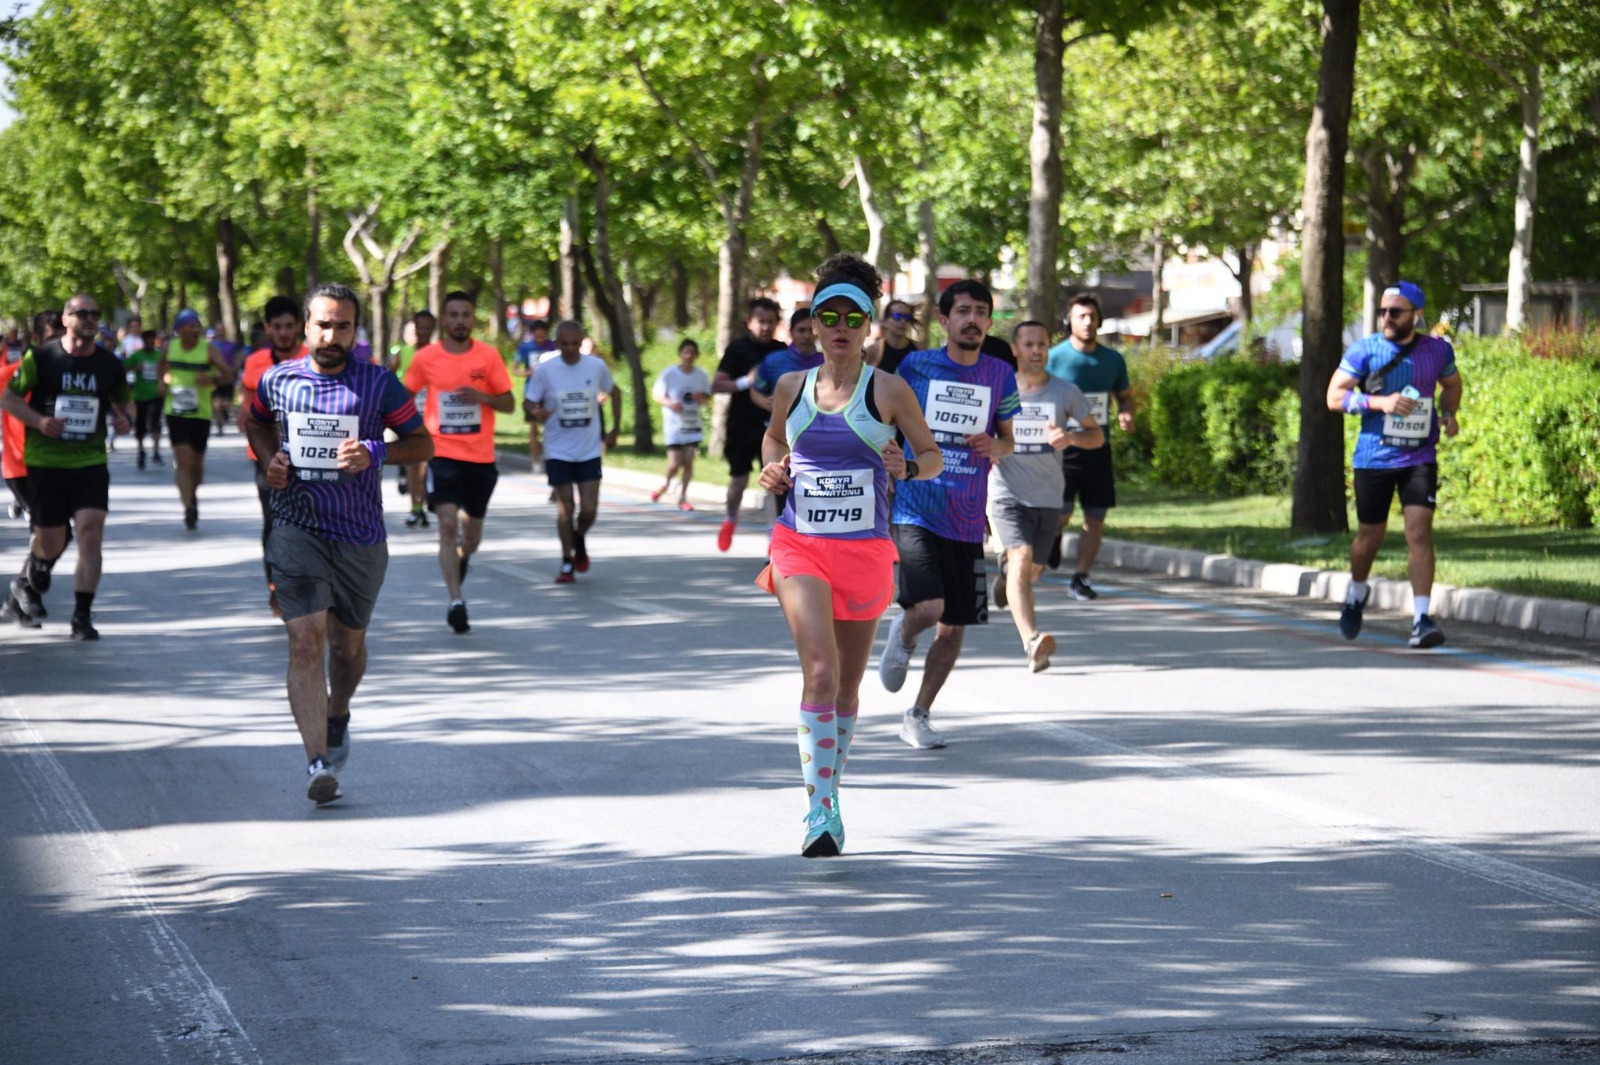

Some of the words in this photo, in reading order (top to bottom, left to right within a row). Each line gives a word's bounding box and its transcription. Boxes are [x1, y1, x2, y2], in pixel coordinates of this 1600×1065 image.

[935, 411, 978, 426] 10674
[1015, 427, 1043, 436] 11071
[301, 447, 338, 459] 1026
[940, 449, 969, 460] ONYA
[944, 457, 961, 466] ARI
[818, 476, 850, 485] KONYA
[807, 488, 860, 497] MARATONU
[807, 508, 862, 522] 10749
